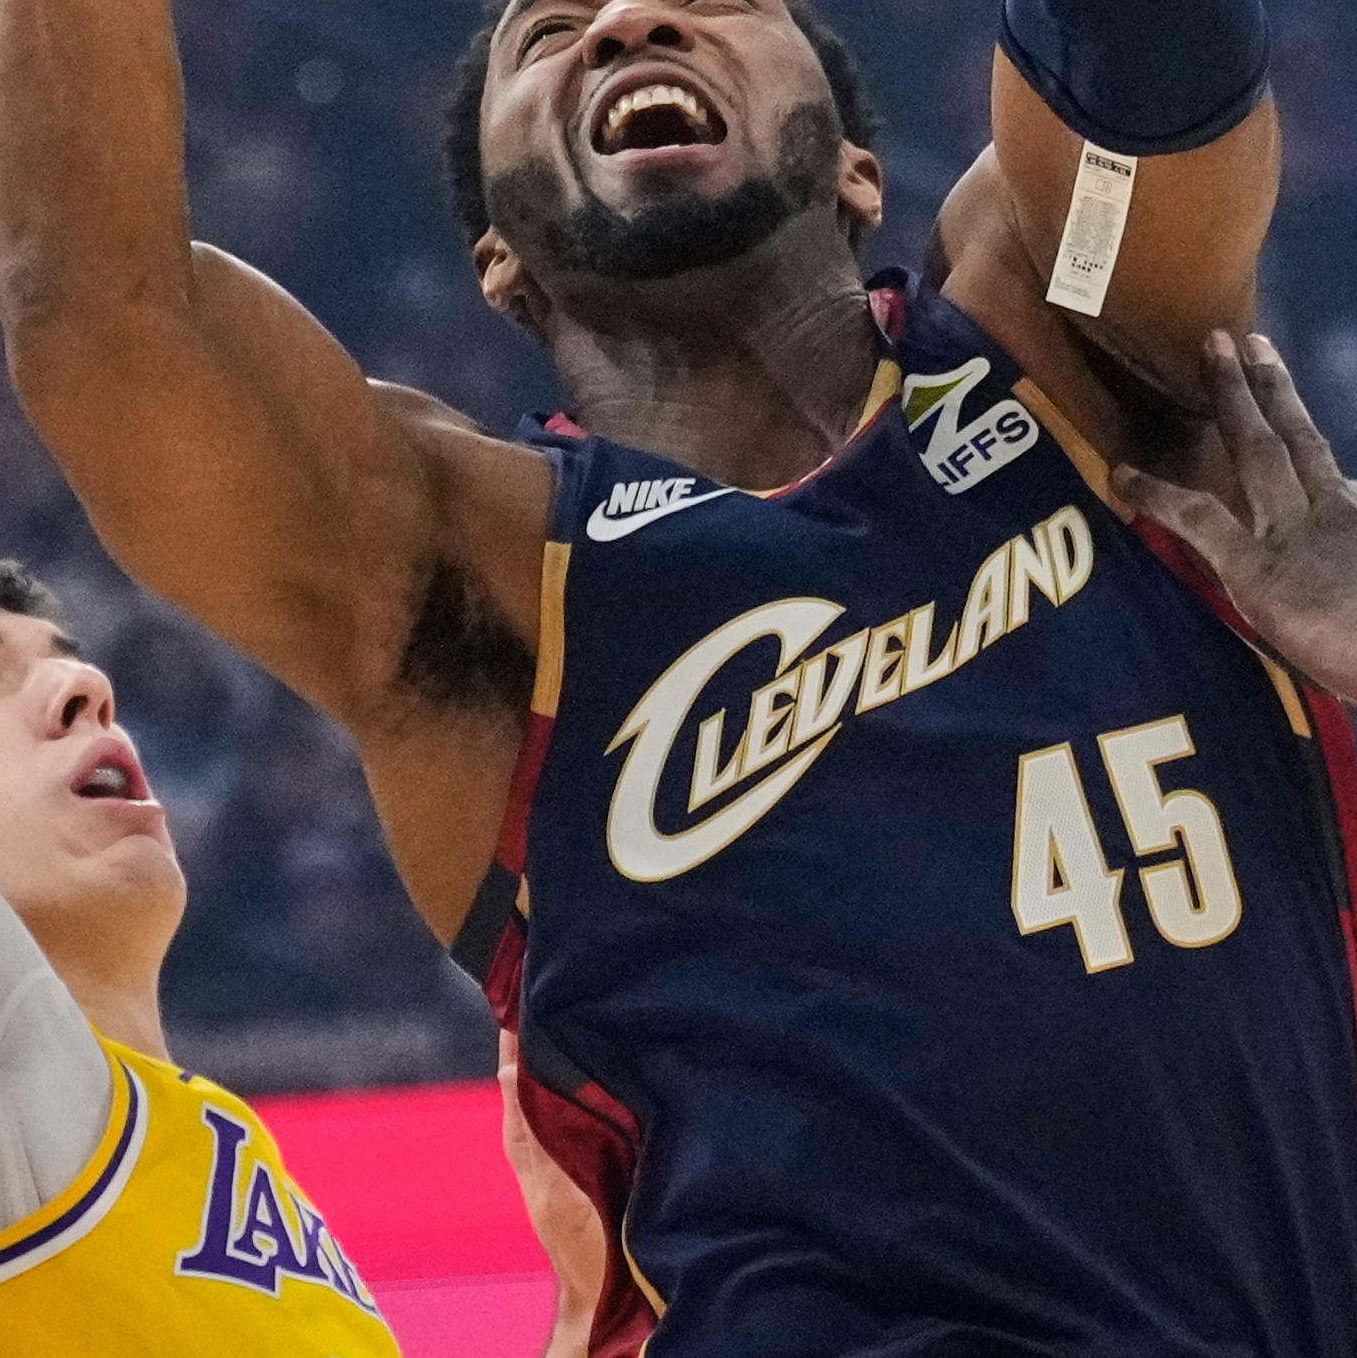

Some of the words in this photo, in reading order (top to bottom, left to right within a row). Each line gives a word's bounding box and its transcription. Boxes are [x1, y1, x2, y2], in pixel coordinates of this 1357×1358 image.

[936, 411, 1030, 485] IFFS
[606, 477, 696, 516] NIKE
[1011, 714, 1242, 974] 45
